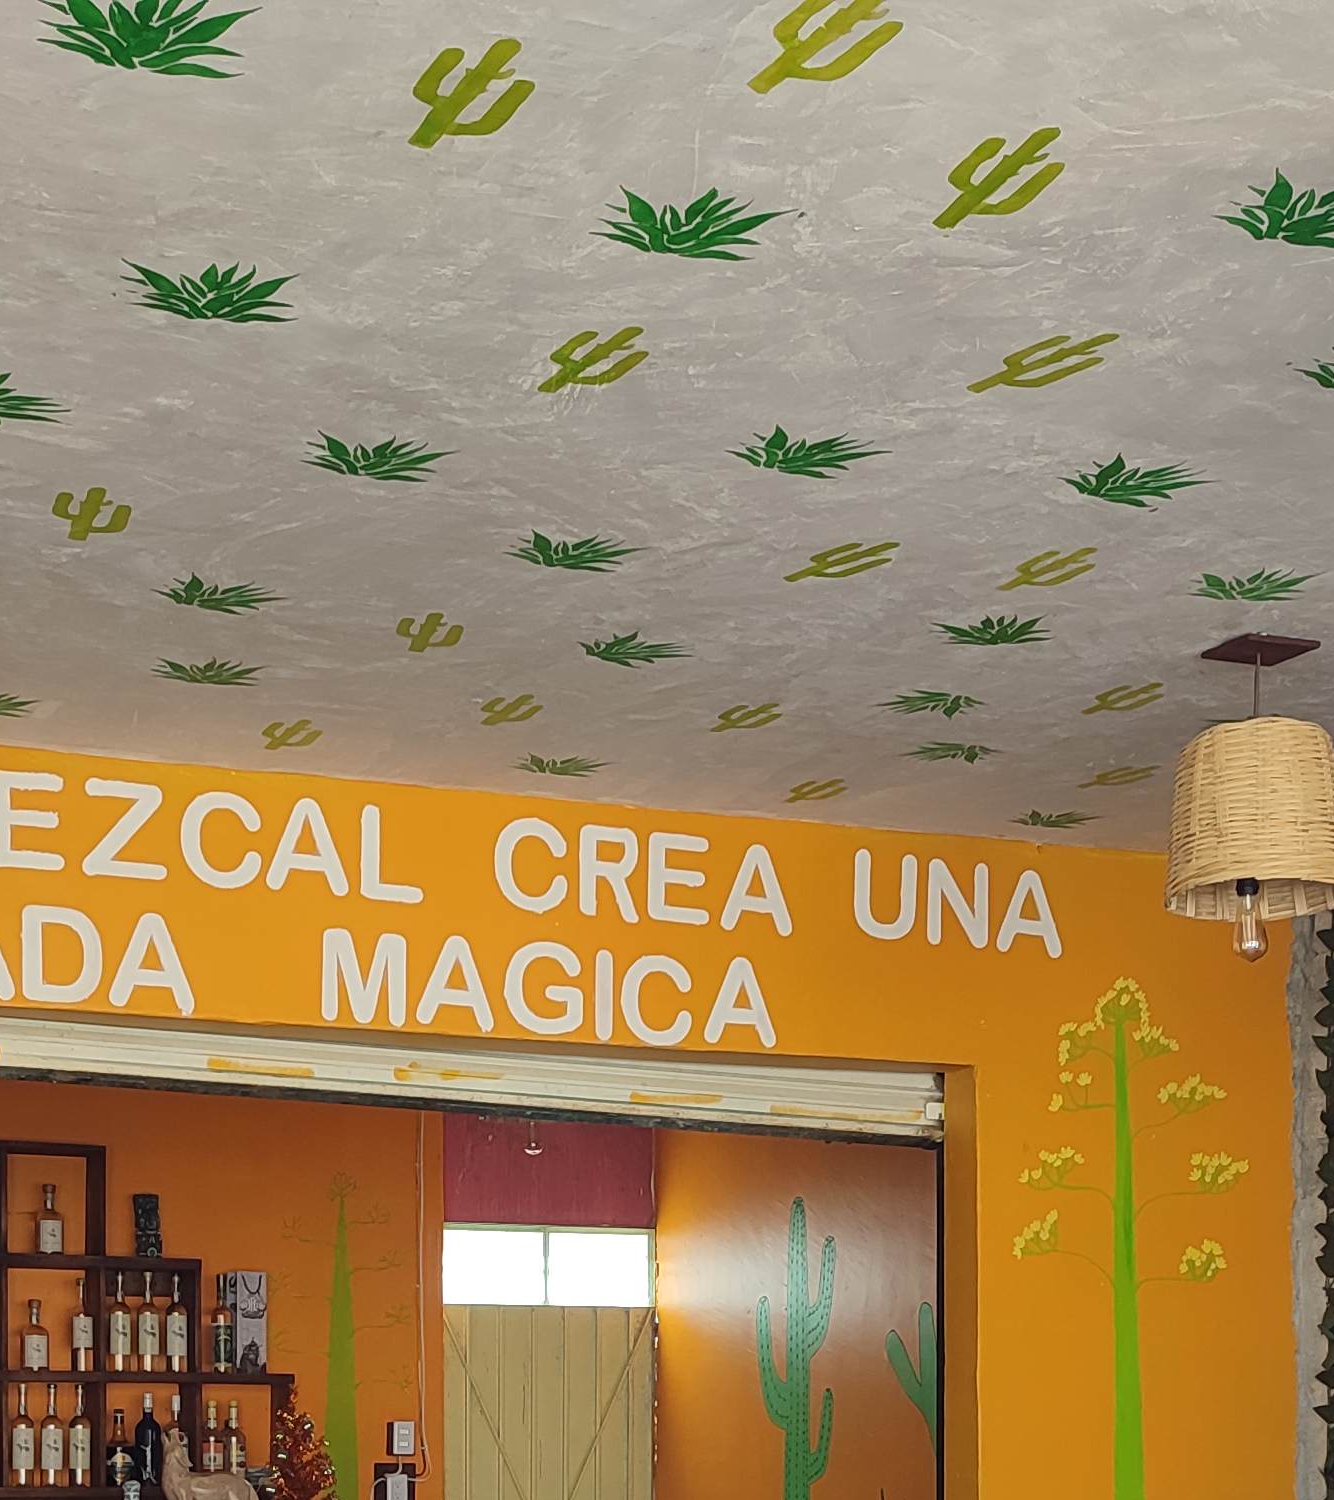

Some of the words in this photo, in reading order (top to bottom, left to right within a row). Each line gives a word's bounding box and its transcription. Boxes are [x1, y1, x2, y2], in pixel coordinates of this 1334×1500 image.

[494, 818, 792, 936] CREA
[854, 848, 1062, 958] UNA
[321, 928, 776, 1048] MAGICA
